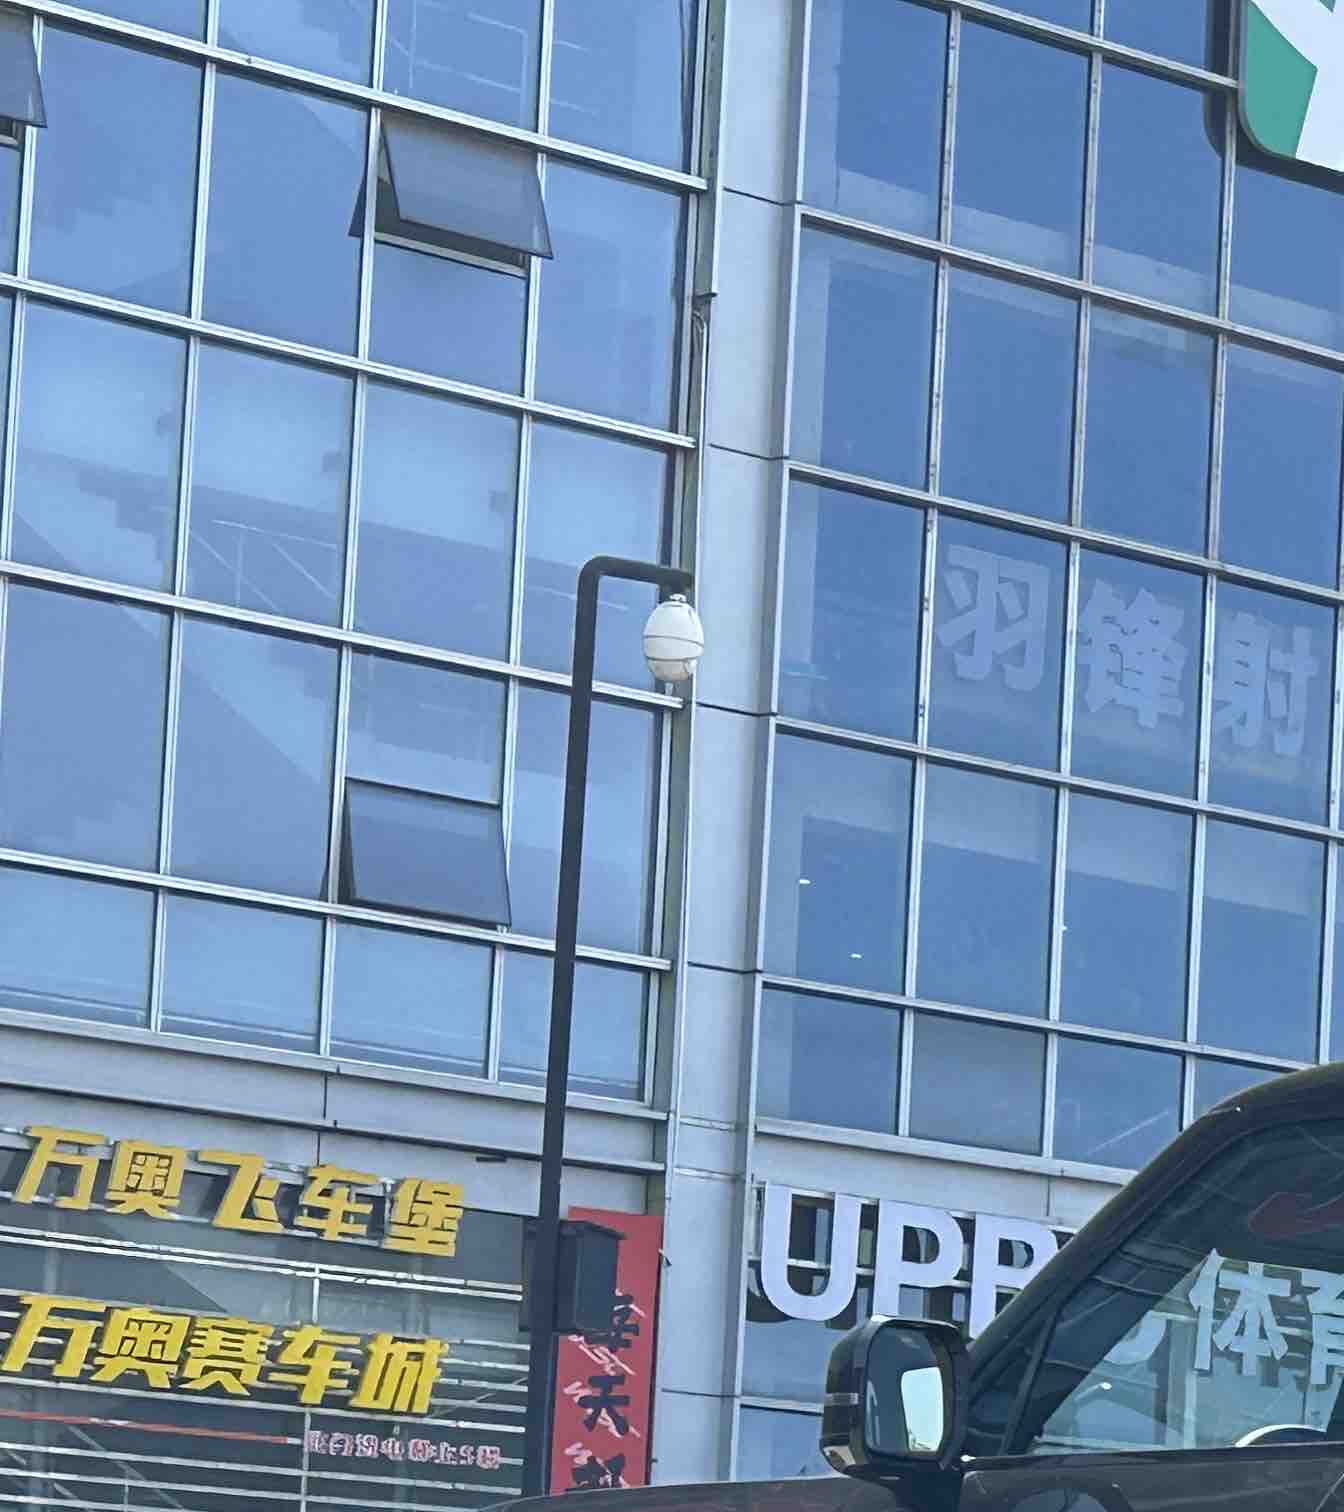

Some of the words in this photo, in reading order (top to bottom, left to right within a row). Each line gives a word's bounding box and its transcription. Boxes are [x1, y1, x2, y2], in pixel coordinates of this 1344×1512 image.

[14, 1124, 465, 1257] 万奥飞车堡
[1, 1294, 449, 1414] 万奥赛车城
